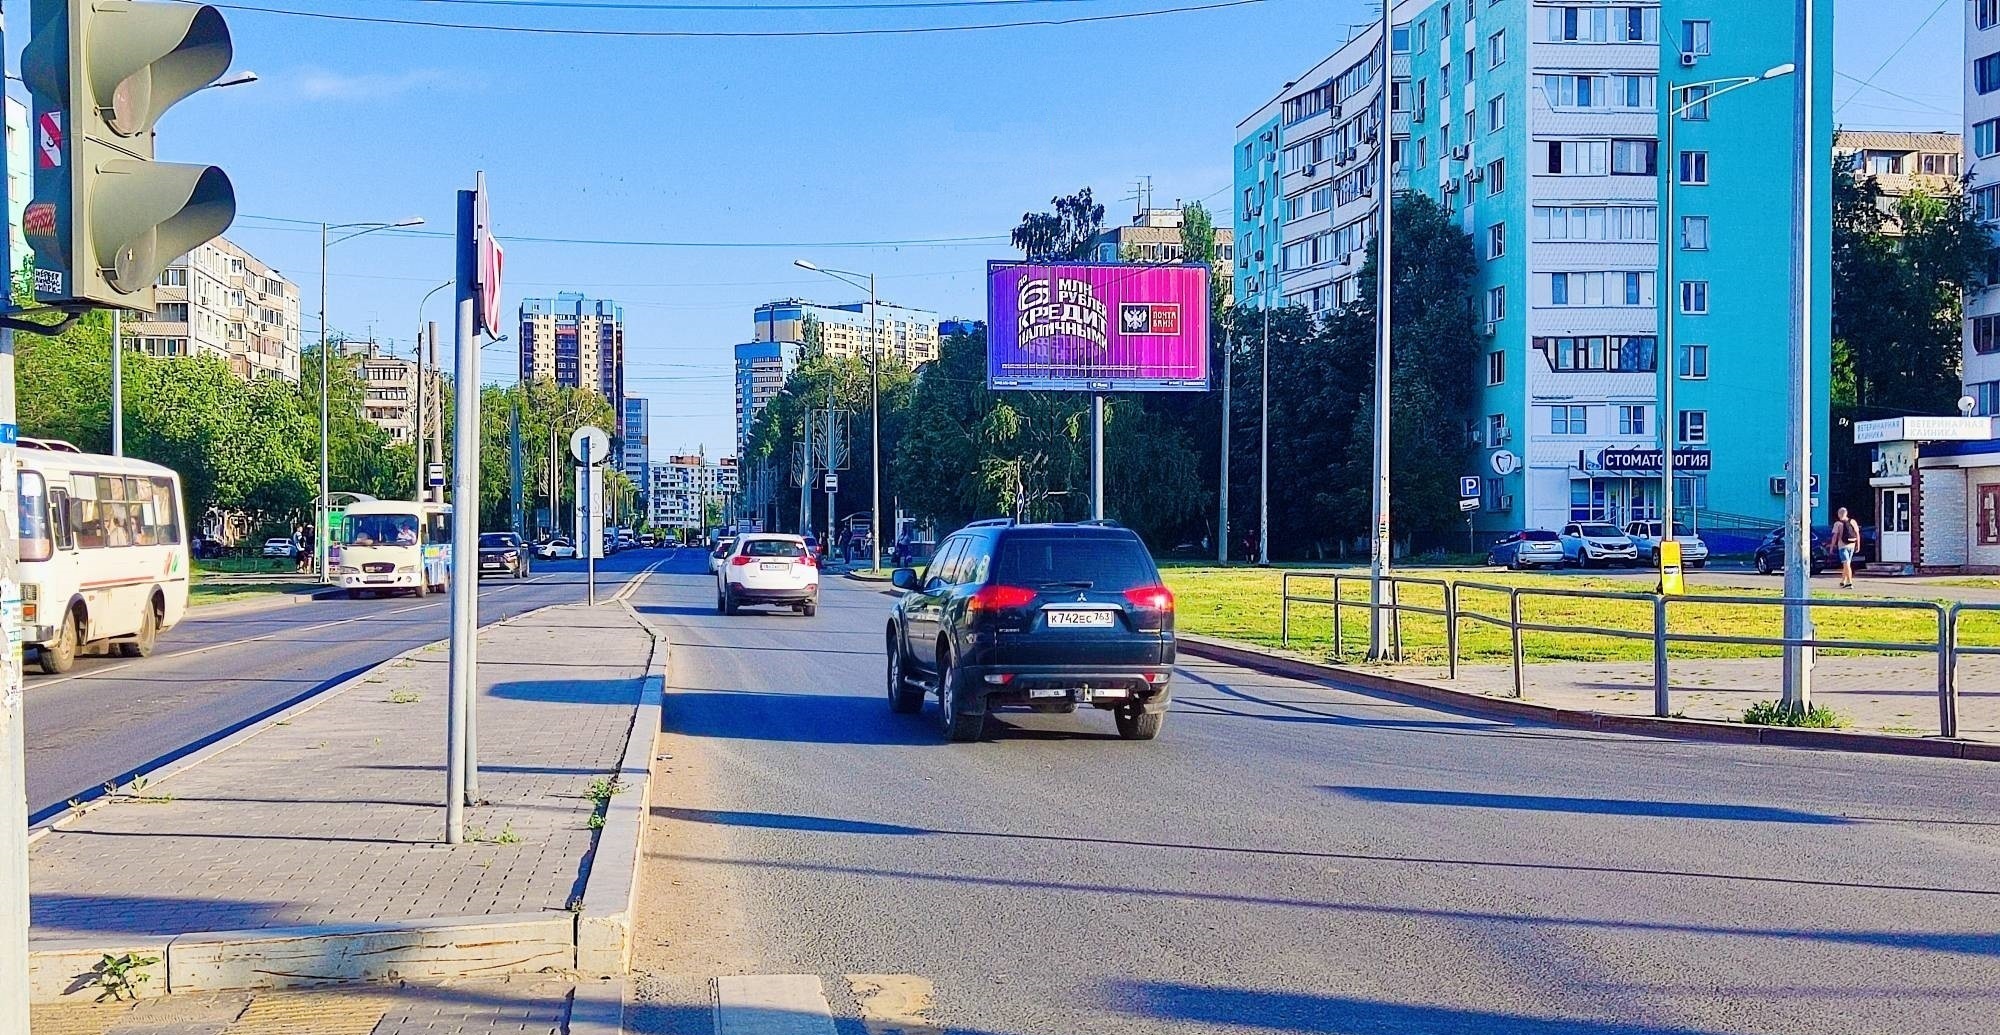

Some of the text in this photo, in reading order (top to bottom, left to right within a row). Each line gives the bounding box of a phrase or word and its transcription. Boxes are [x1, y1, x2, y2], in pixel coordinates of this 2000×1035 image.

[1018, 278, 1093, 311] 6 МЛН
[1152, 311, 1177, 320] ПОЧТА
[1152, 319, 1174, 328] БАНК
[1857, 420, 1900, 432] ВЕТЕРИНАРНАЯ
[1910, 419, 1985, 428] ВЕТЕРИНАРНАЯ
[1857, 432, 1884, 441] КЛИНИКА
[1910, 428, 1958, 437] КЛИНИКА
[1605, 454, 1708, 467] СТОМАТООГИЯ
[1465, 478, 1477, 495] P
